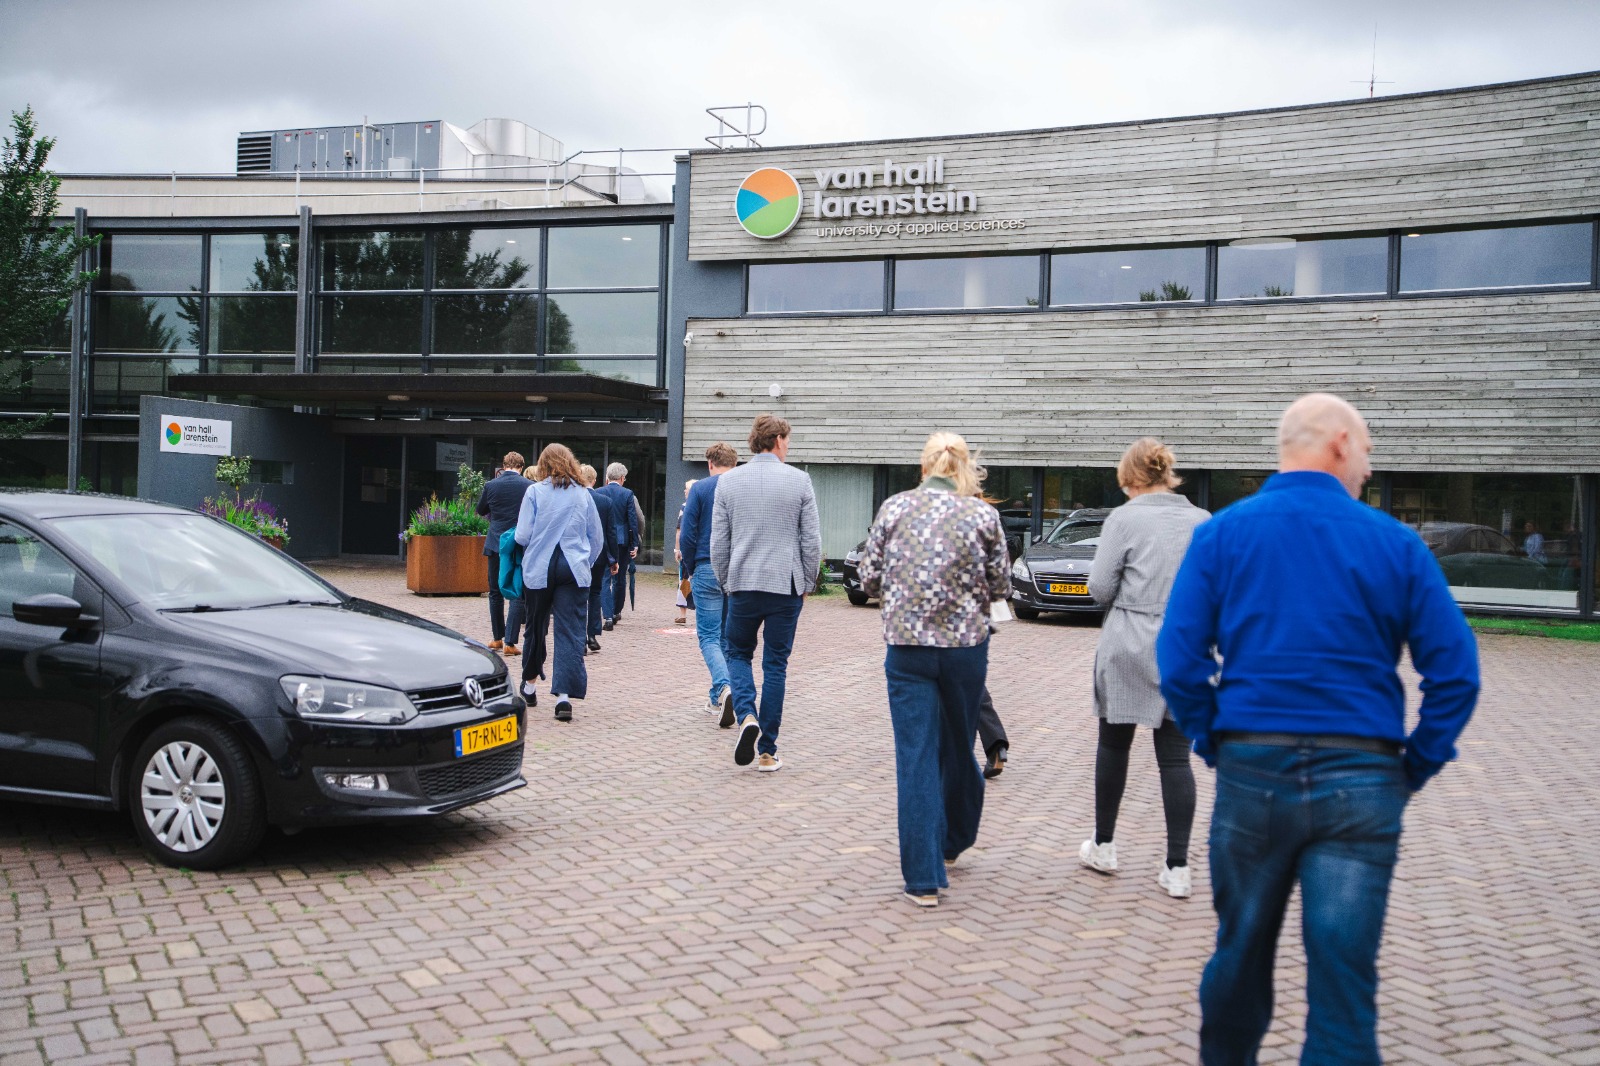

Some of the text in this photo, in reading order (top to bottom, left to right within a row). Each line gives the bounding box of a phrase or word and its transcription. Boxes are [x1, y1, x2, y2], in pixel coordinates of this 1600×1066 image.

[814, 156, 944, 190] van hall
[814, 185, 977, 218] larenstein
[816, 218, 1026, 237] university of applied sciences
[183, 424, 211, 434] van hall
[183, 432, 218, 442] larenstein
[467, 721, 512, 750] 17-RNL-9
